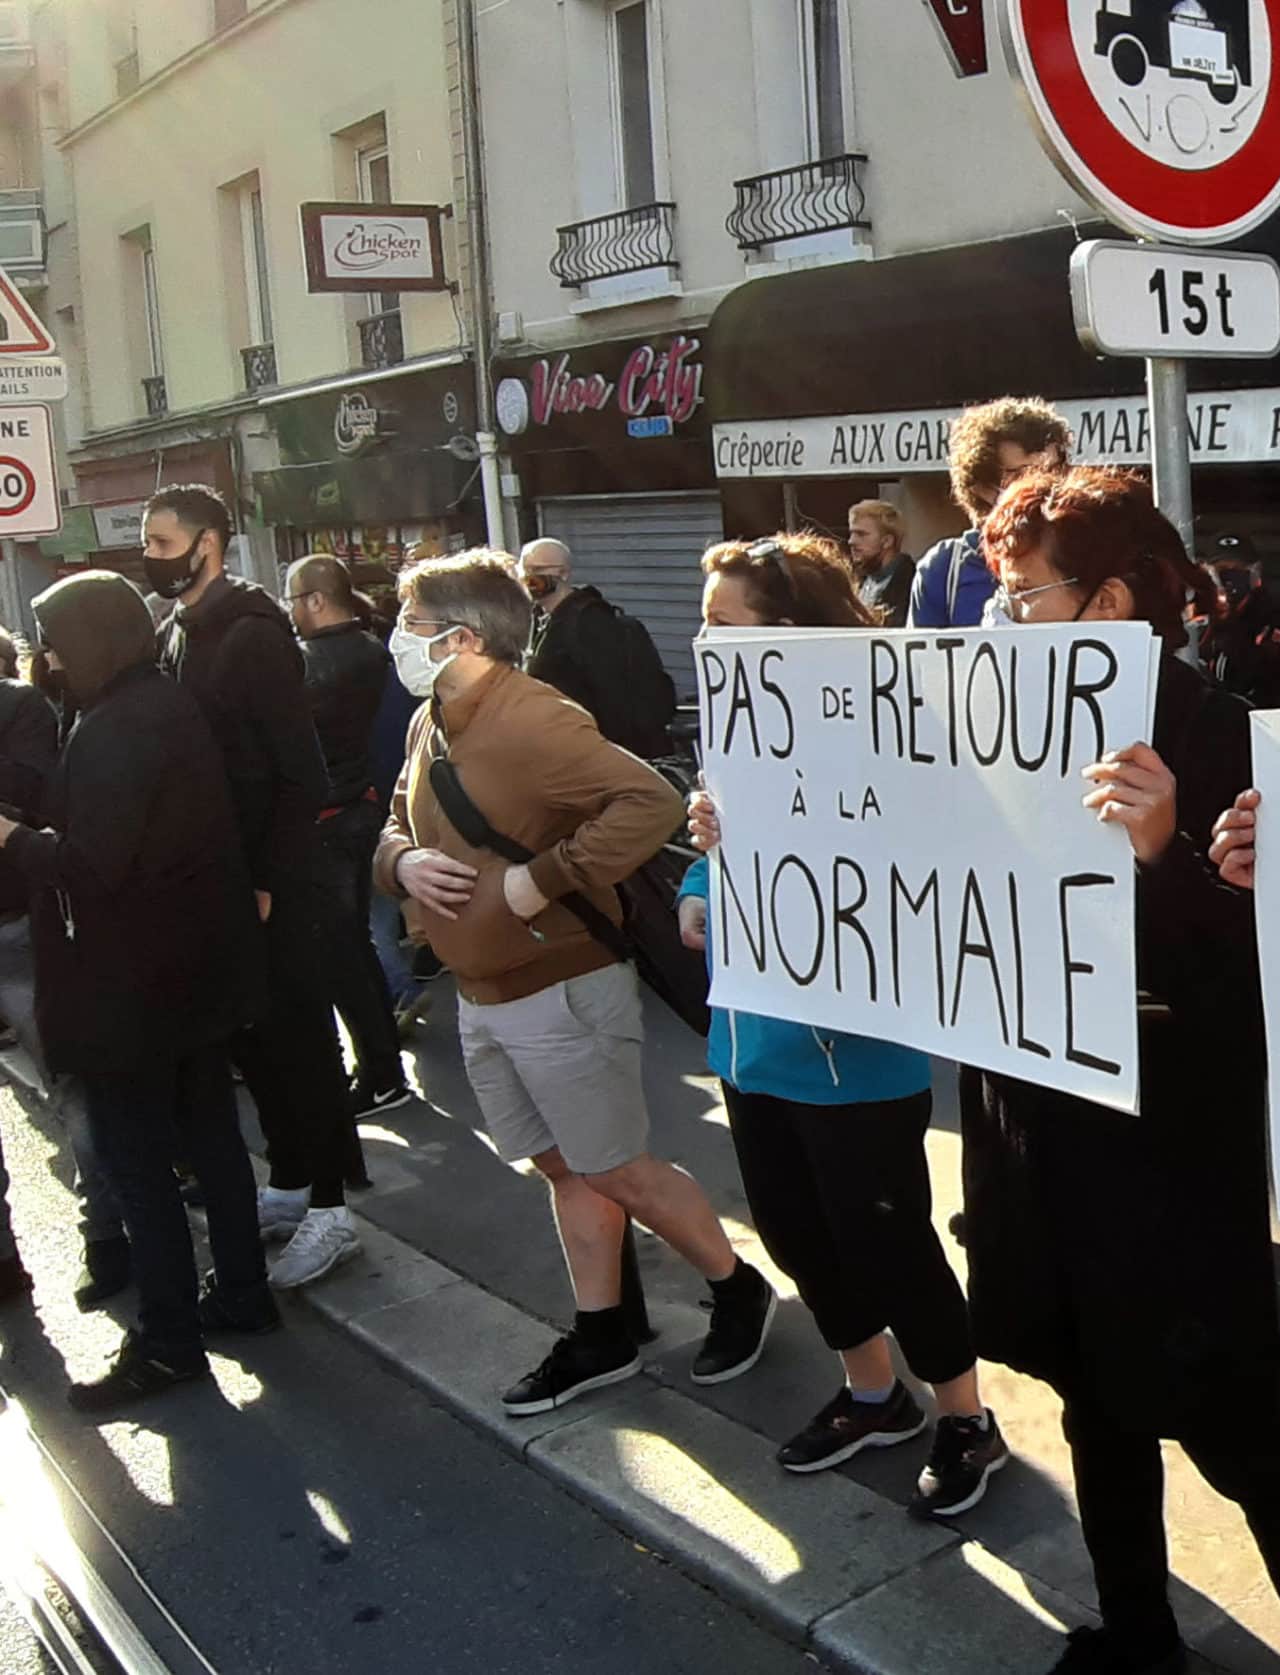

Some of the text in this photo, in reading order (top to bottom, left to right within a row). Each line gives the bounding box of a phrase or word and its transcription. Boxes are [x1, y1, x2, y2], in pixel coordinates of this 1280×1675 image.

[1149, 268, 1235, 337] 15t
[619, 335, 704, 423] City
[717, 432, 804, 475] Crêperie
[830, 423, 887, 465] AUX
[1077, 403, 1232, 455] MARNE
[0, 473, 22, 498] 0
[699, 637, 1119, 782] PAS DE RETOUR
[790, 768, 882, 821] À LA
[717, 848, 1122, 1076] NORMALE
